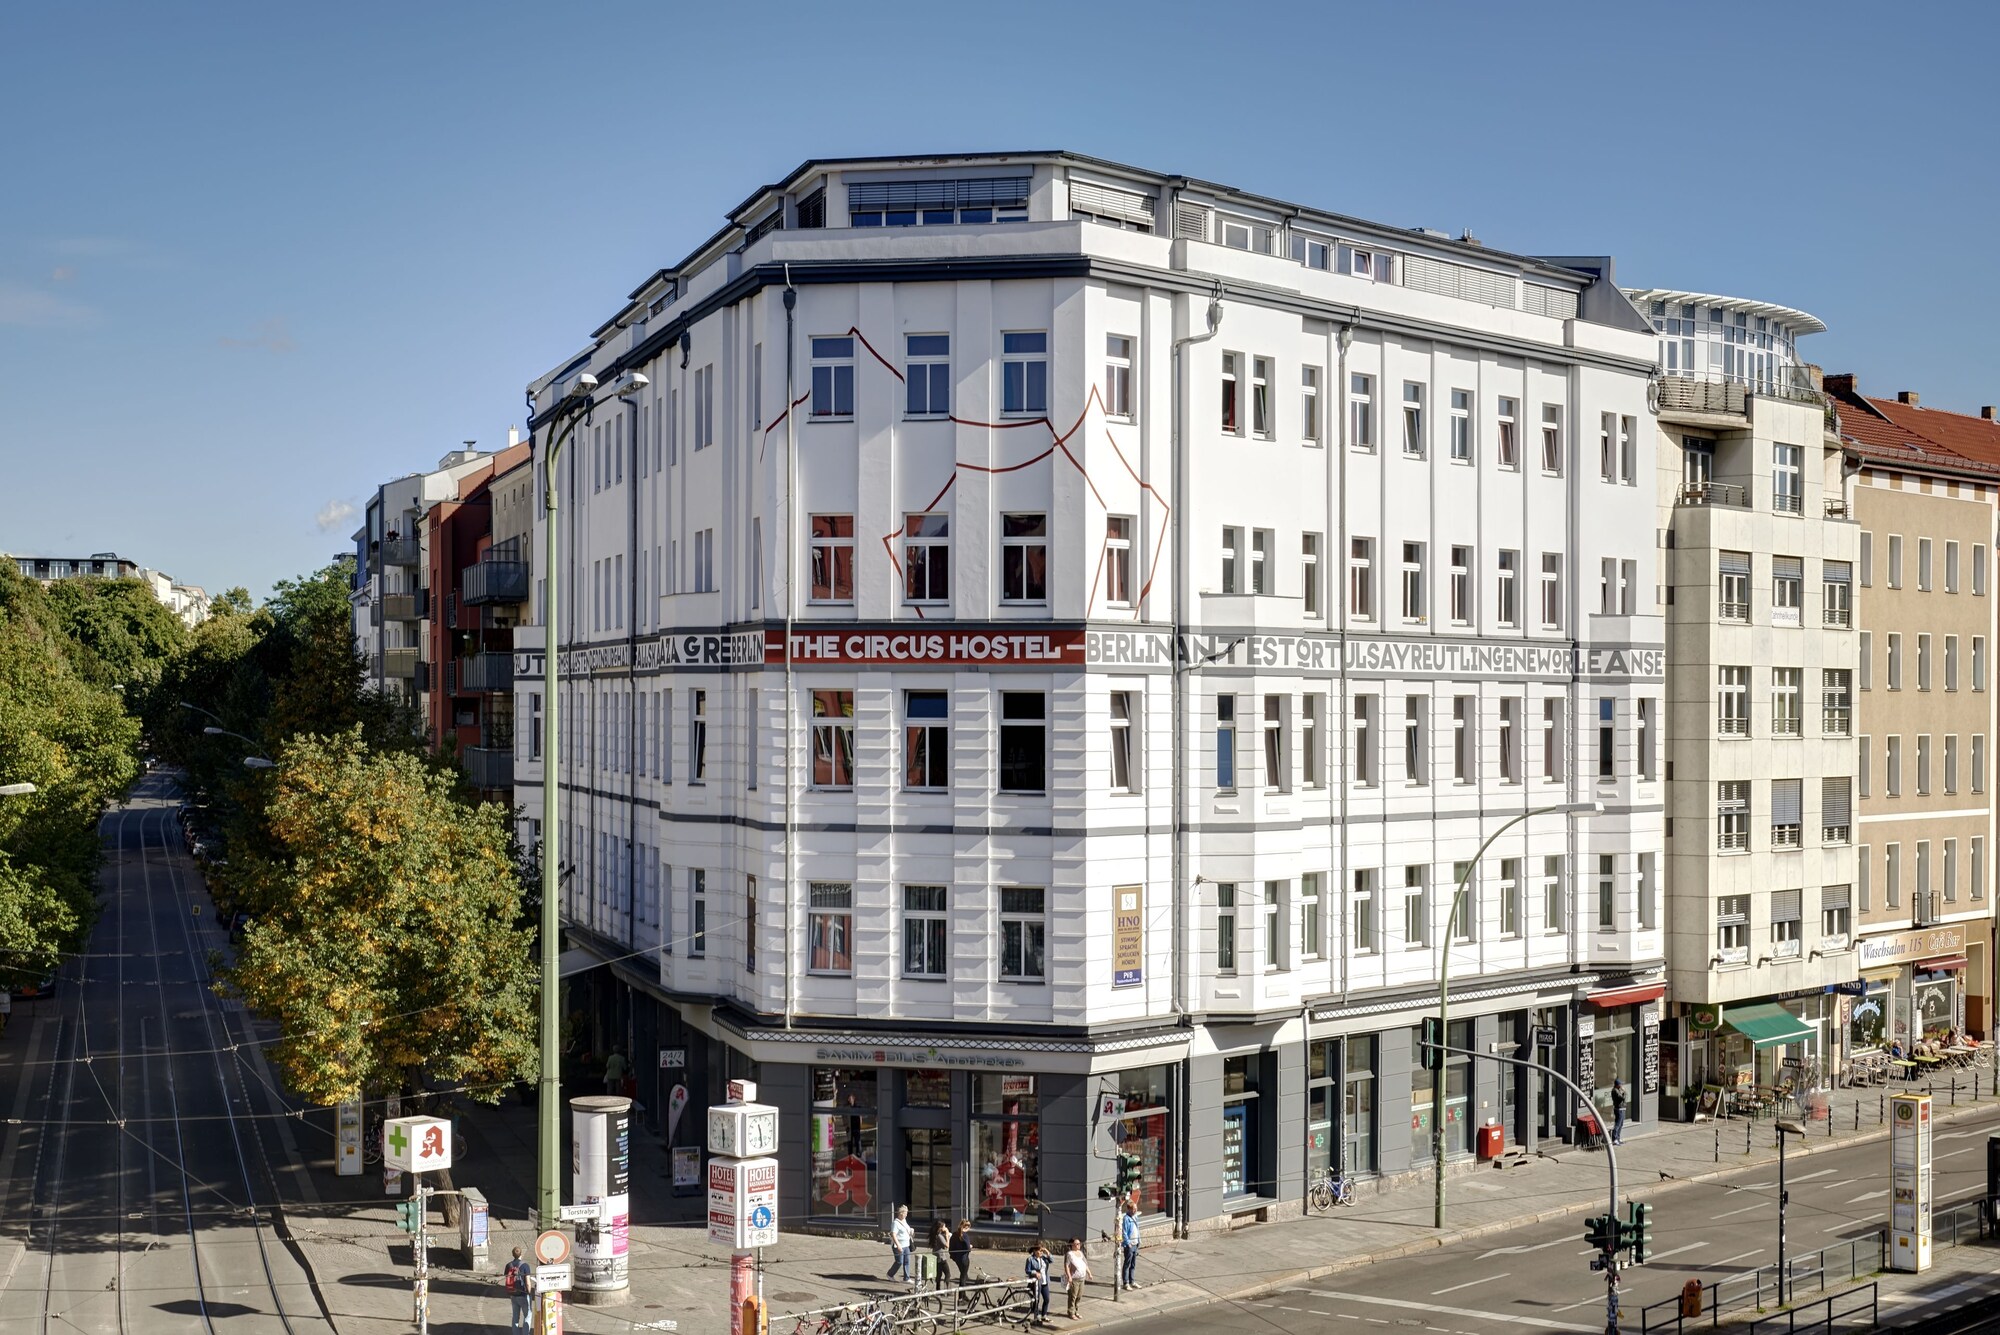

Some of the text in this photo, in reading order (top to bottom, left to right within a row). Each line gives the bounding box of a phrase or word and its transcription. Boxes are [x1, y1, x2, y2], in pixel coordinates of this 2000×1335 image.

[790, 634, 1062, 660] THE CIRCUS HOSTEL
[1118, 916, 1140, 927] HNO
[1863, 940, 1906, 960] Waschsalon
[1909, 937, 1922, 953] 115
[1945, 931, 1960, 948] Bar
[1841, 982, 1862, 990] KIND
[662, 1051, 682, 1059] 24/7
[711, 1165, 734, 1182] HOTEL
[749, 1166, 774, 1182] HOTEL
[567, 1208, 595, 1216] Torstraße
[548, 1280, 560, 1288] frei
